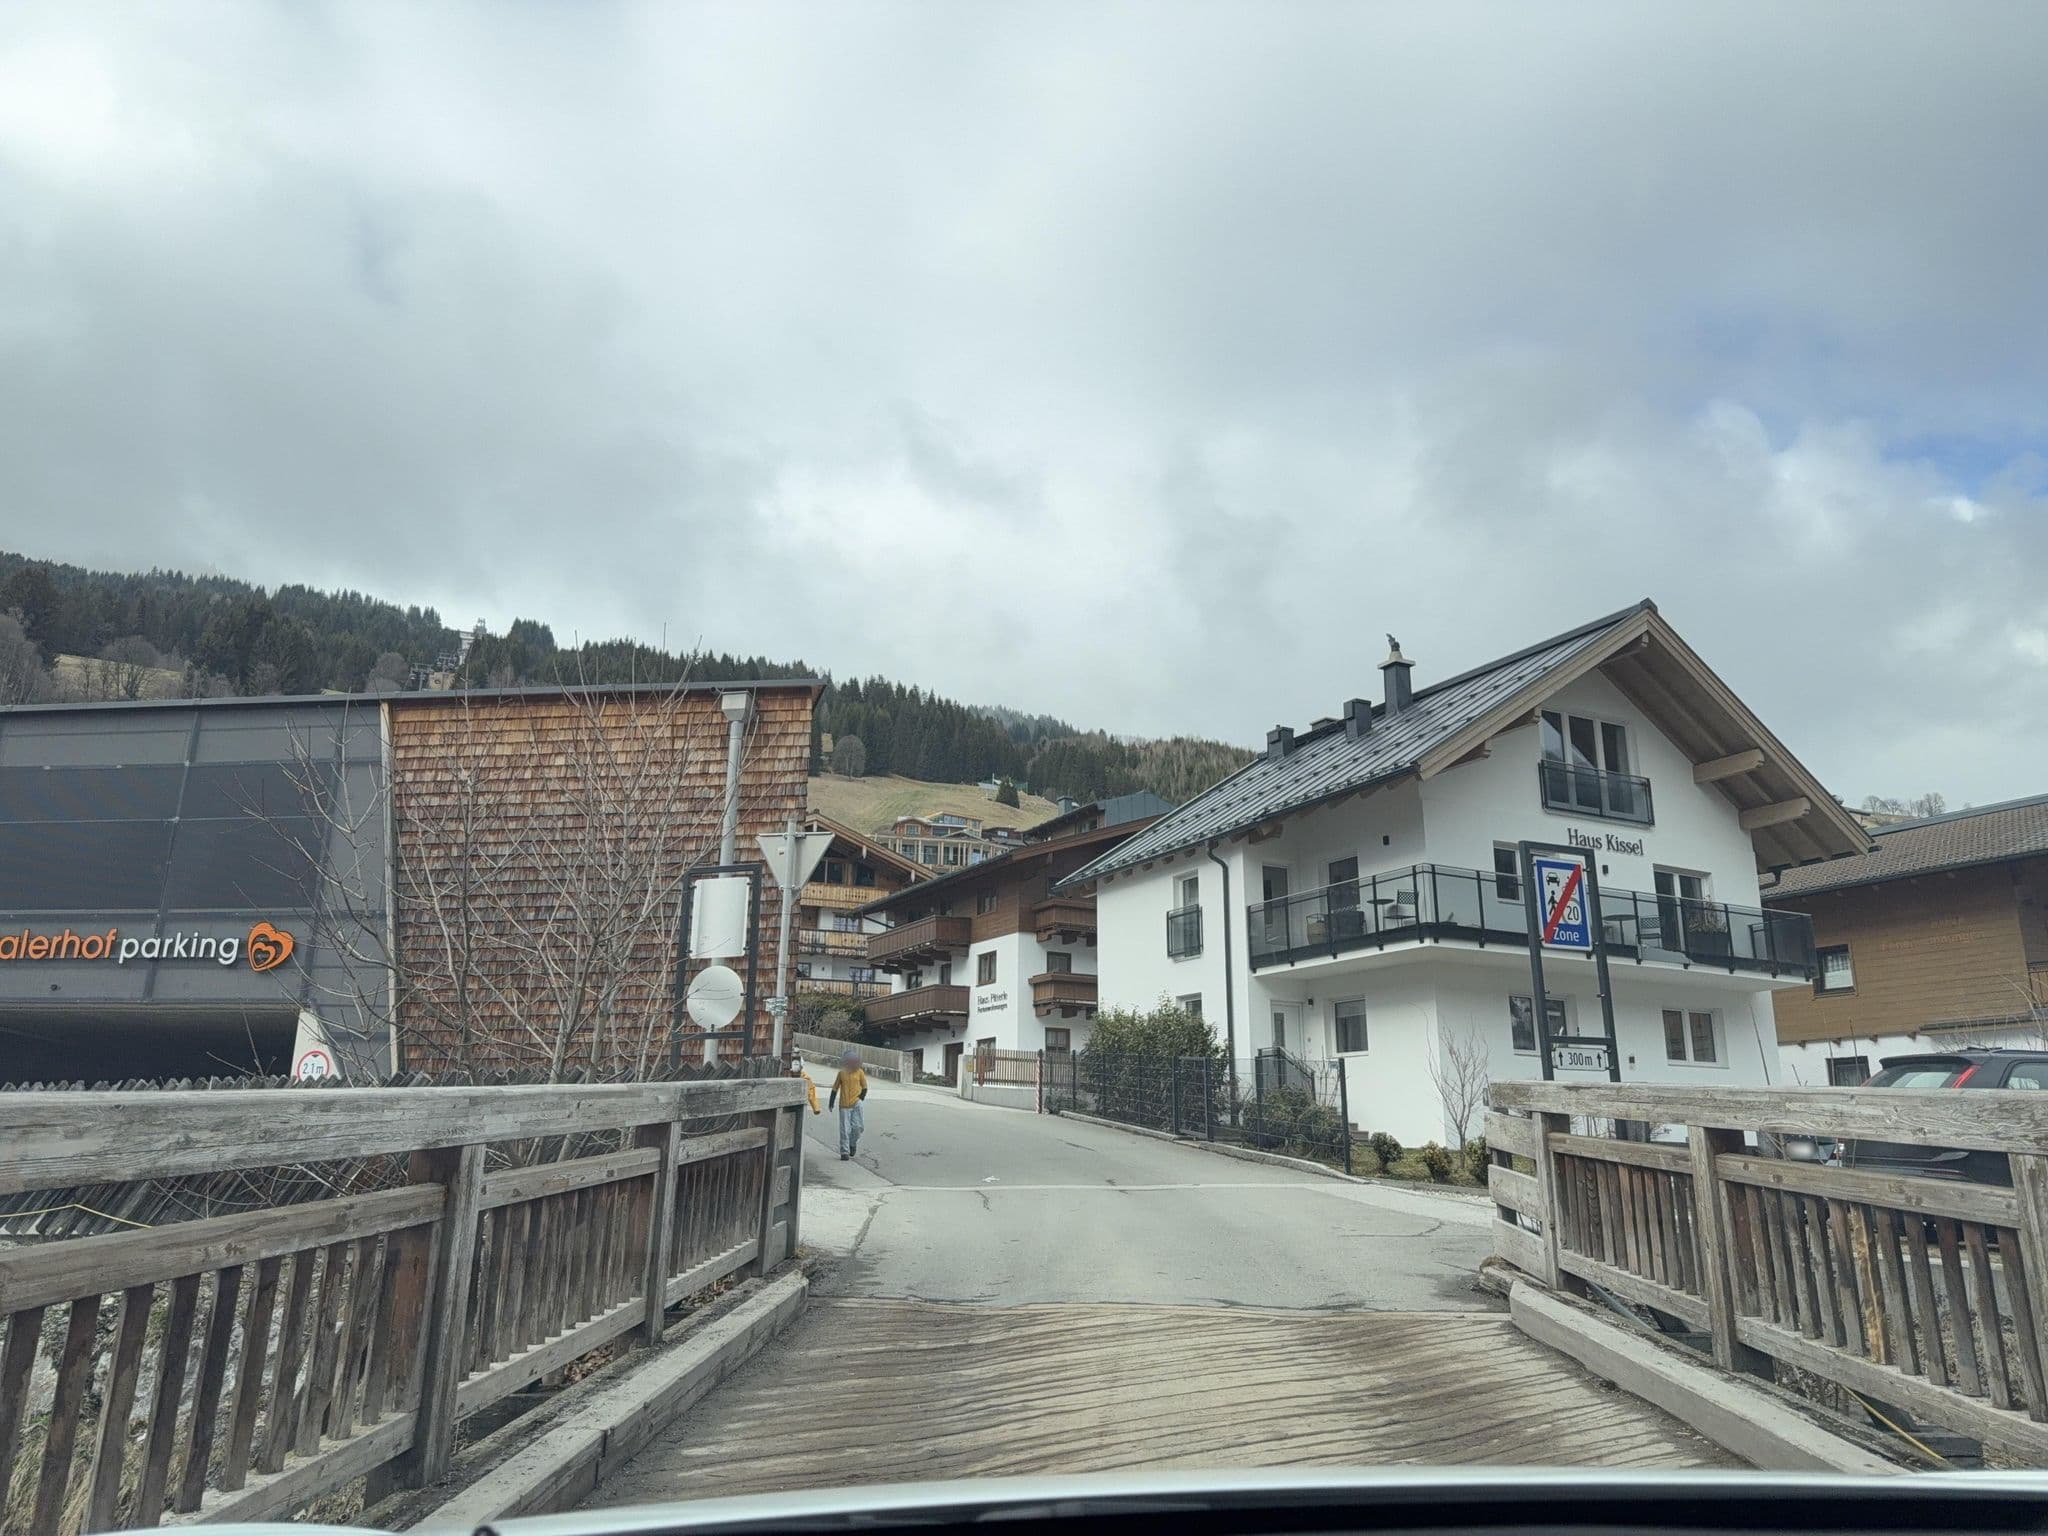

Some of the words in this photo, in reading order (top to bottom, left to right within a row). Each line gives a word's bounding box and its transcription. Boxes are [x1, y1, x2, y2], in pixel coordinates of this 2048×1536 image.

[1567, 827, 1602, 849] Haus
[1605, 833, 1643, 856] Kissel
[1566, 905, 1580, 921] 20
[1552, 926, 1580, 942] Zone
[0, 928, 118, 959] alerhof
[118, 931, 240, 965] parking
